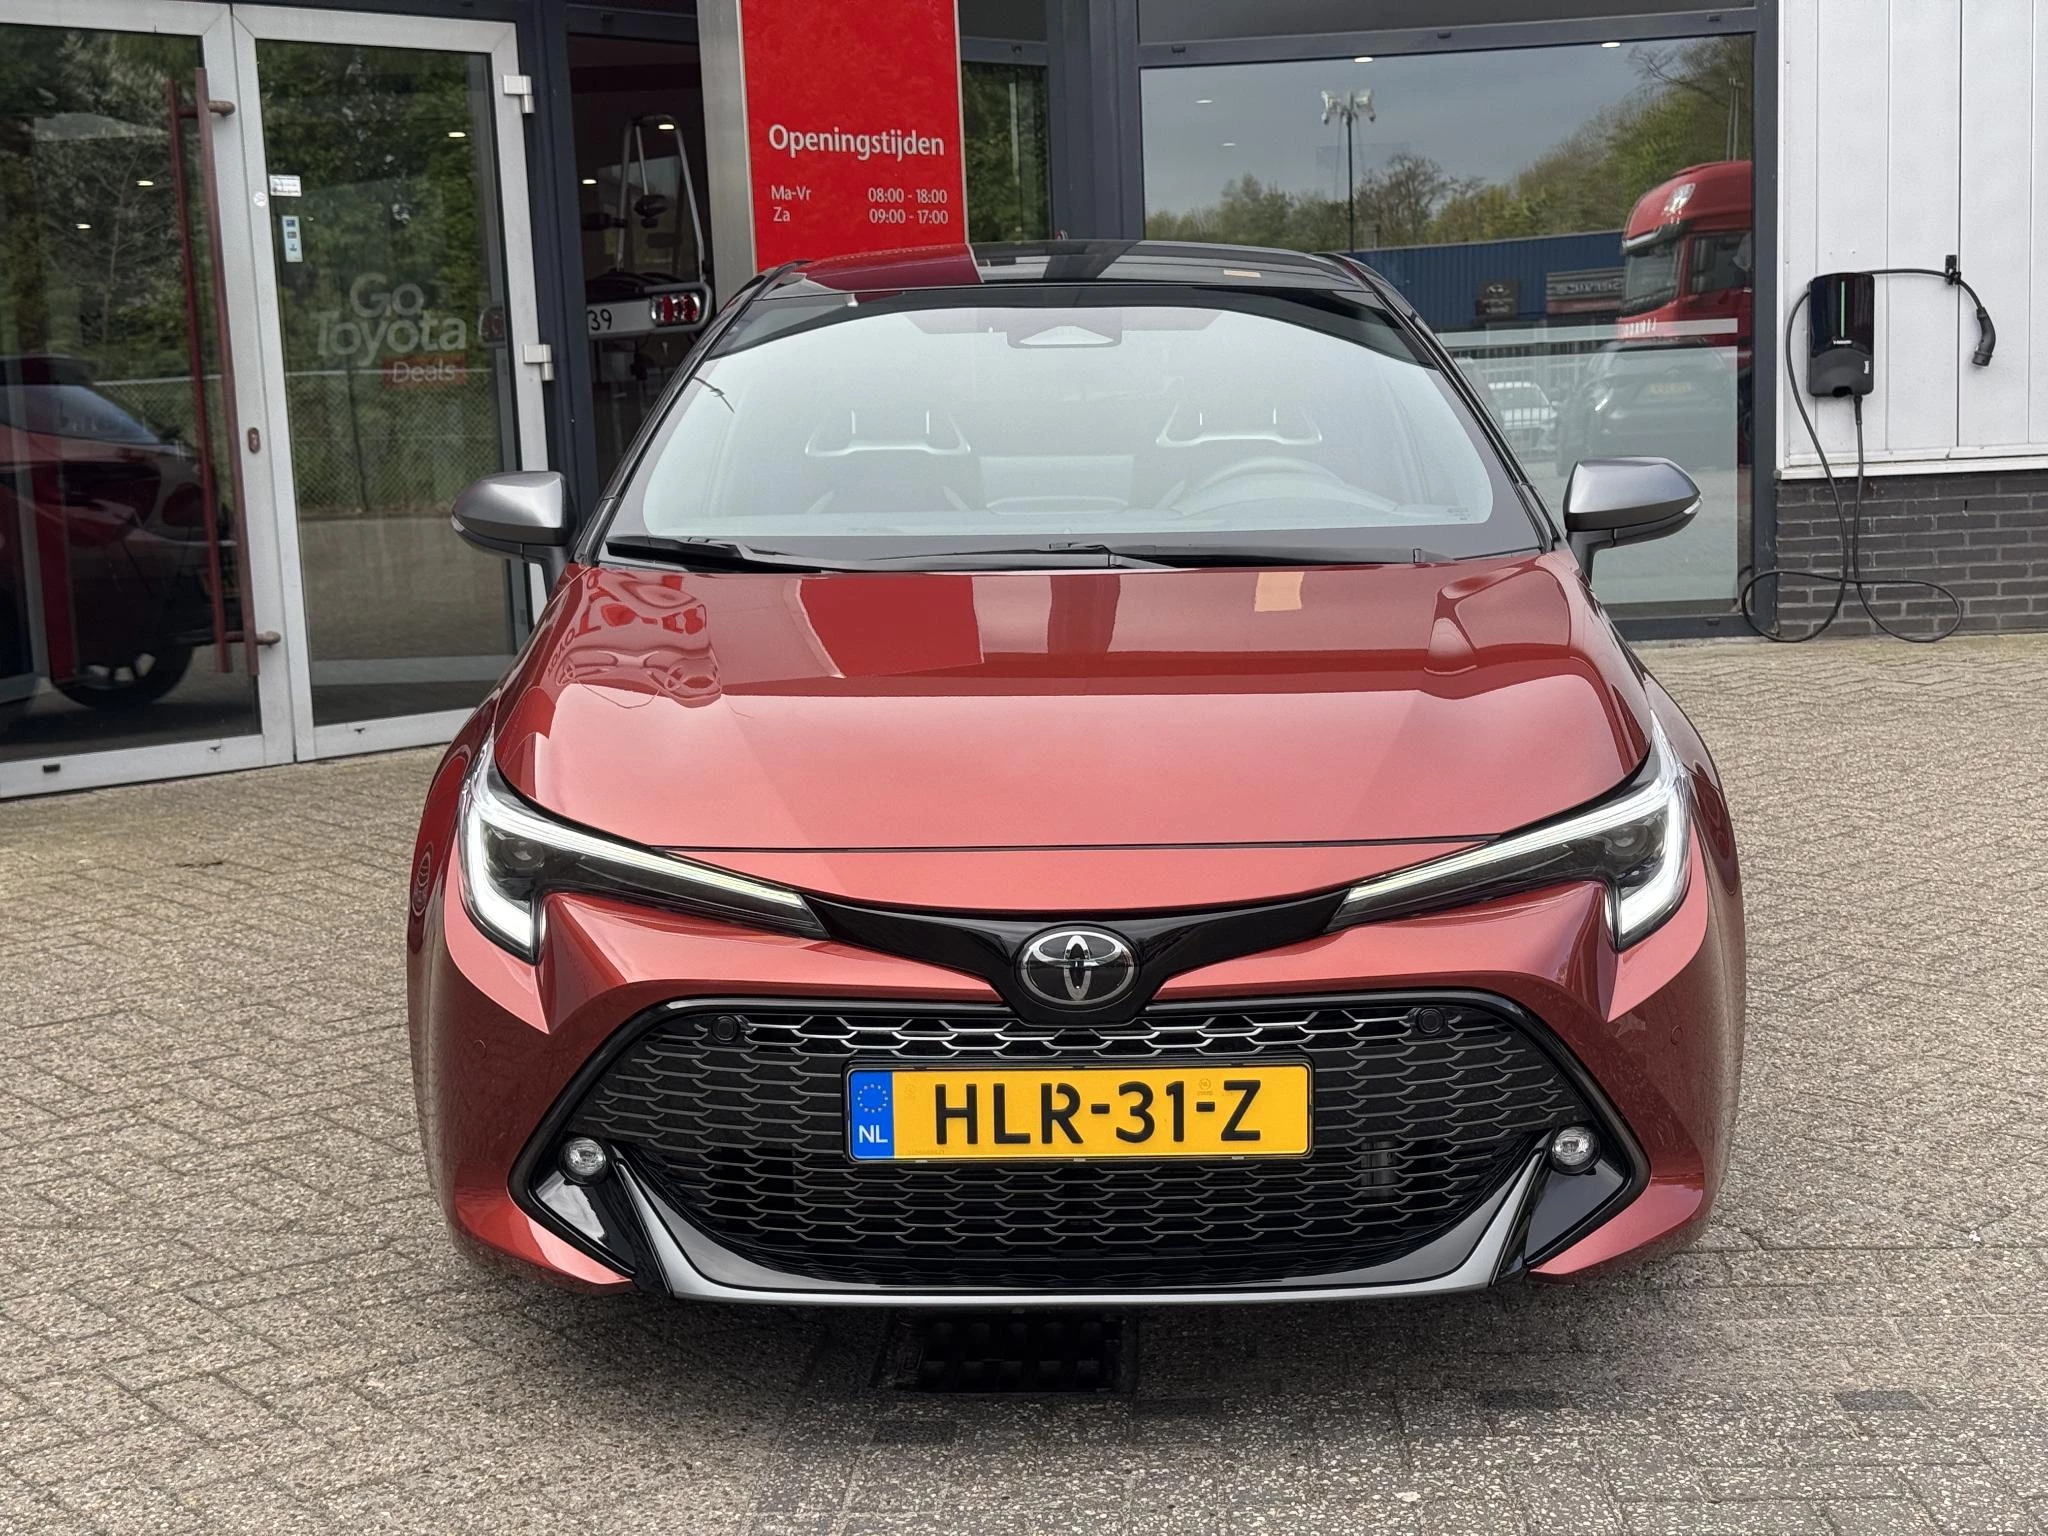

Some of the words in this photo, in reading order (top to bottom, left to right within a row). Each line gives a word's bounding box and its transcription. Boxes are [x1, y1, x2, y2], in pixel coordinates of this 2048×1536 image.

[769, 124, 945, 162] Openingstijden
[771, 184, 812, 201] Ma-Vr
[868, 187, 904, 203] 08:00
[916, 189, 948, 204] 18:00
[773, 206, 791, 222] Za
[869, 208, 906, 224] 09:00
[917, 209, 949, 225] 17:00
[351, 272, 424, 318] Go
[310, 309, 468, 367] Toyota
[392, 358, 456, 384] Deals
[934, 1079, 1262, 1146] HLR-31-Z
[858, 1124, 889, 1144] NL
